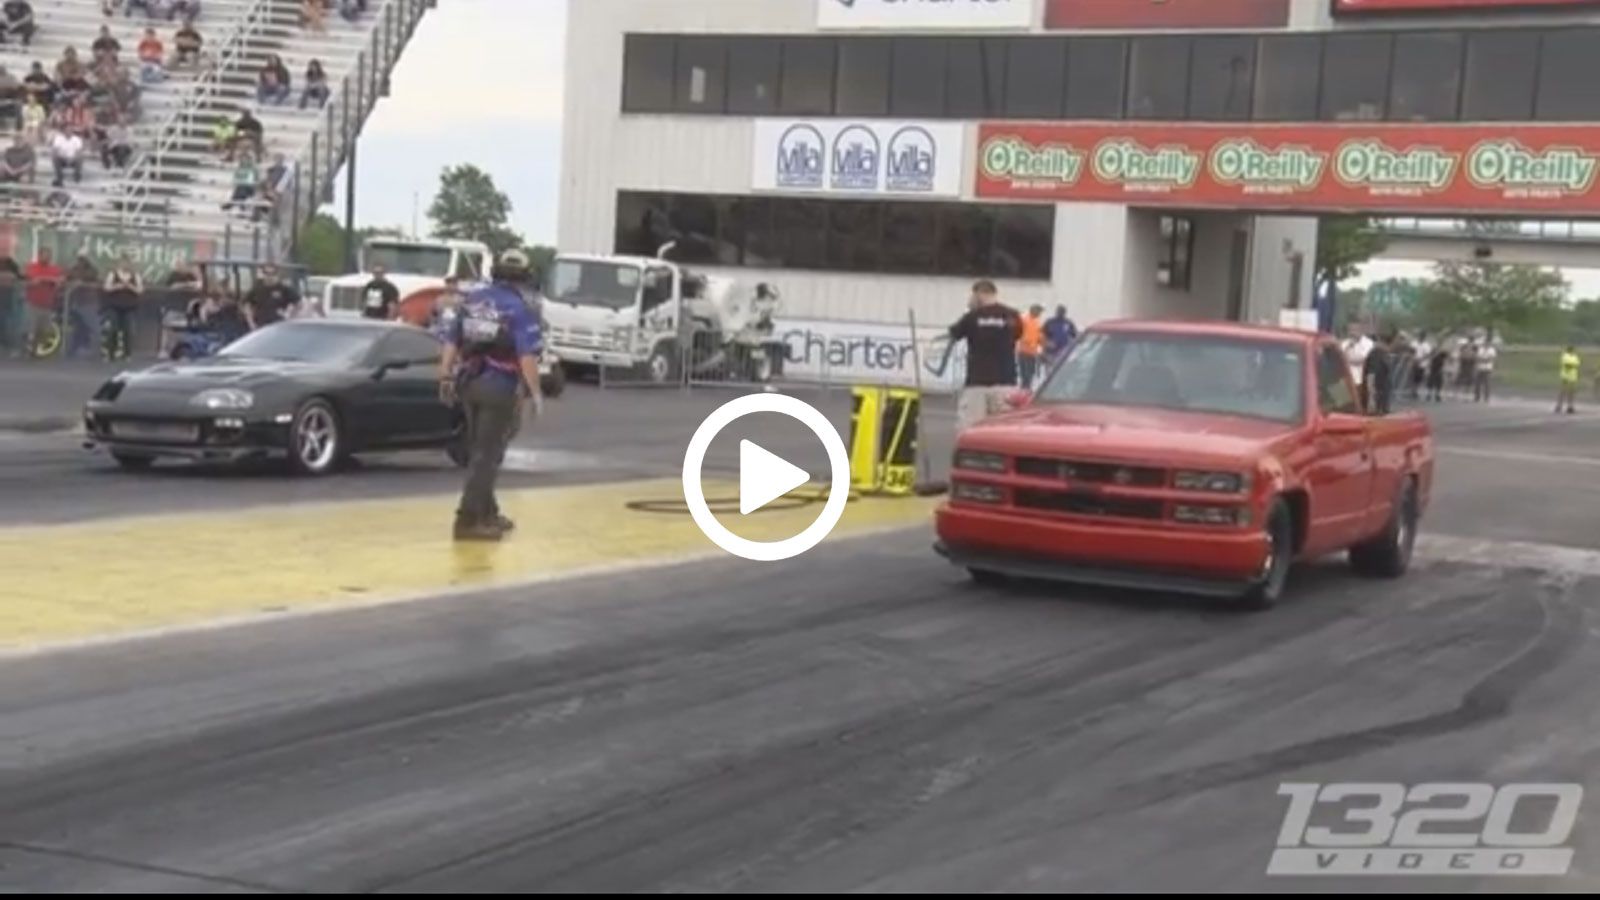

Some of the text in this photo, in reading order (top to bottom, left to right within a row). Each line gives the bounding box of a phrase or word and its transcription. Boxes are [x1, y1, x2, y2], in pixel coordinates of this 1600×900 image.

[986, 140, 1594, 188] O'Reilly O'Reilly O'Reilly O'Reilly O'Reilly
[783, 329, 914, 370] Charter
